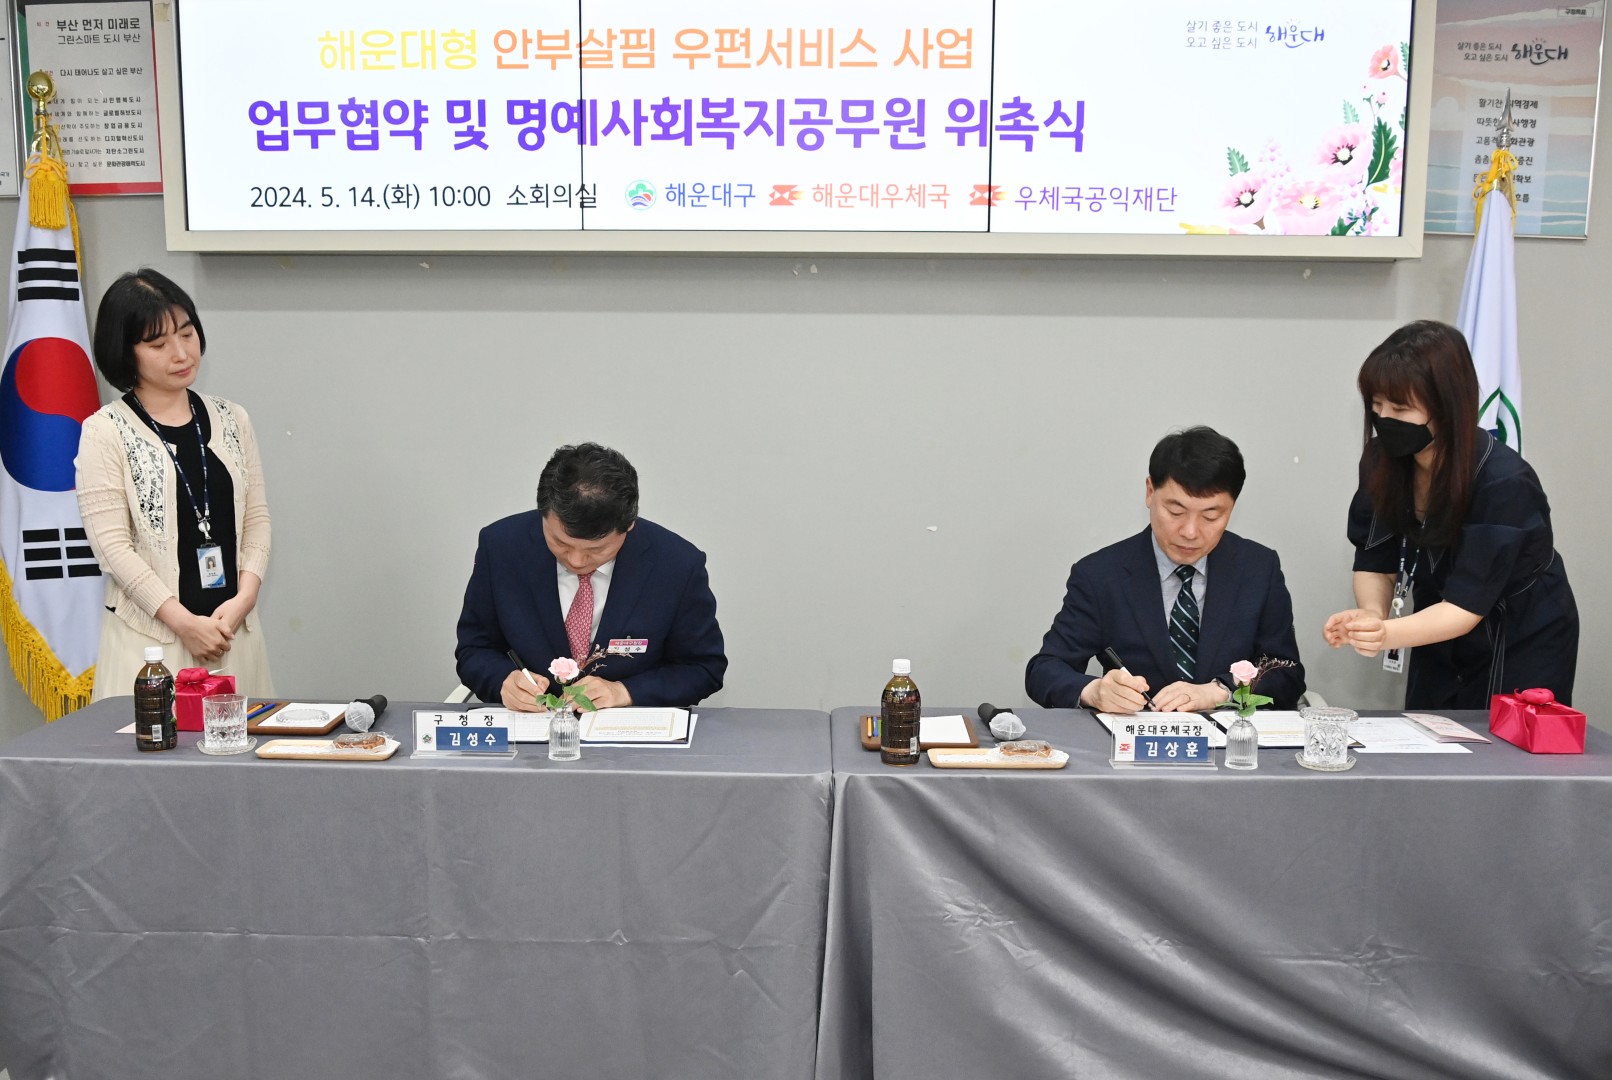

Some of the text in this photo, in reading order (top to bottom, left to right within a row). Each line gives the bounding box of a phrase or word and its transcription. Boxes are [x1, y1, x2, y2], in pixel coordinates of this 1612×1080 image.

[56, 17, 140, 32] 부산 먼저 미래로
[1186, 20, 1258, 33] 살기 좋은 도시
[57, 33, 141, 45] 그린스마트 도시 부산
[1265, 19, 1325, 49] 해운대
[317, 27, 973, 72] 해운대형 안부살핌 우편서비스 사업
[1185, 36, 1258, 50] 오고 싶은 도시
[1457, 42, 1472, 50] 살기
[1488, 42, 1502, 50] 도시
[1463, 52, 1508, 62] 오고 싶은 도시
[1511, 41, 1569, 66] 해운대
[60, 69, 73, 77] 다시
[75, 68, 100, 76] 태어나도
[102, 67, 114, 76] 살고
[130, 67, 143, 75] 부산
[1478, 98, 1503, 108] 활기찬
[247, 95, 1087, 153] 업무협약 및 명예사회복지공무원 위촉식
[1512, 118, 1537, 129] 사행정
[1509, 137, 1535, 147] 화관광
[1474, 155, 1492, 164] 촘촘
[249, 181, 1179, 214] 2024. 5. 14.(화) 10:00 소회의실 해운대구 해운대우체국 우체국공익재단
[433, 713, 495, 727] 구청장
[1125, 724, 1203, 737] 해운대우체국장
[448, 731, 498, 748] 김성수
[1145, 741, 1199, 758] 김상훈
